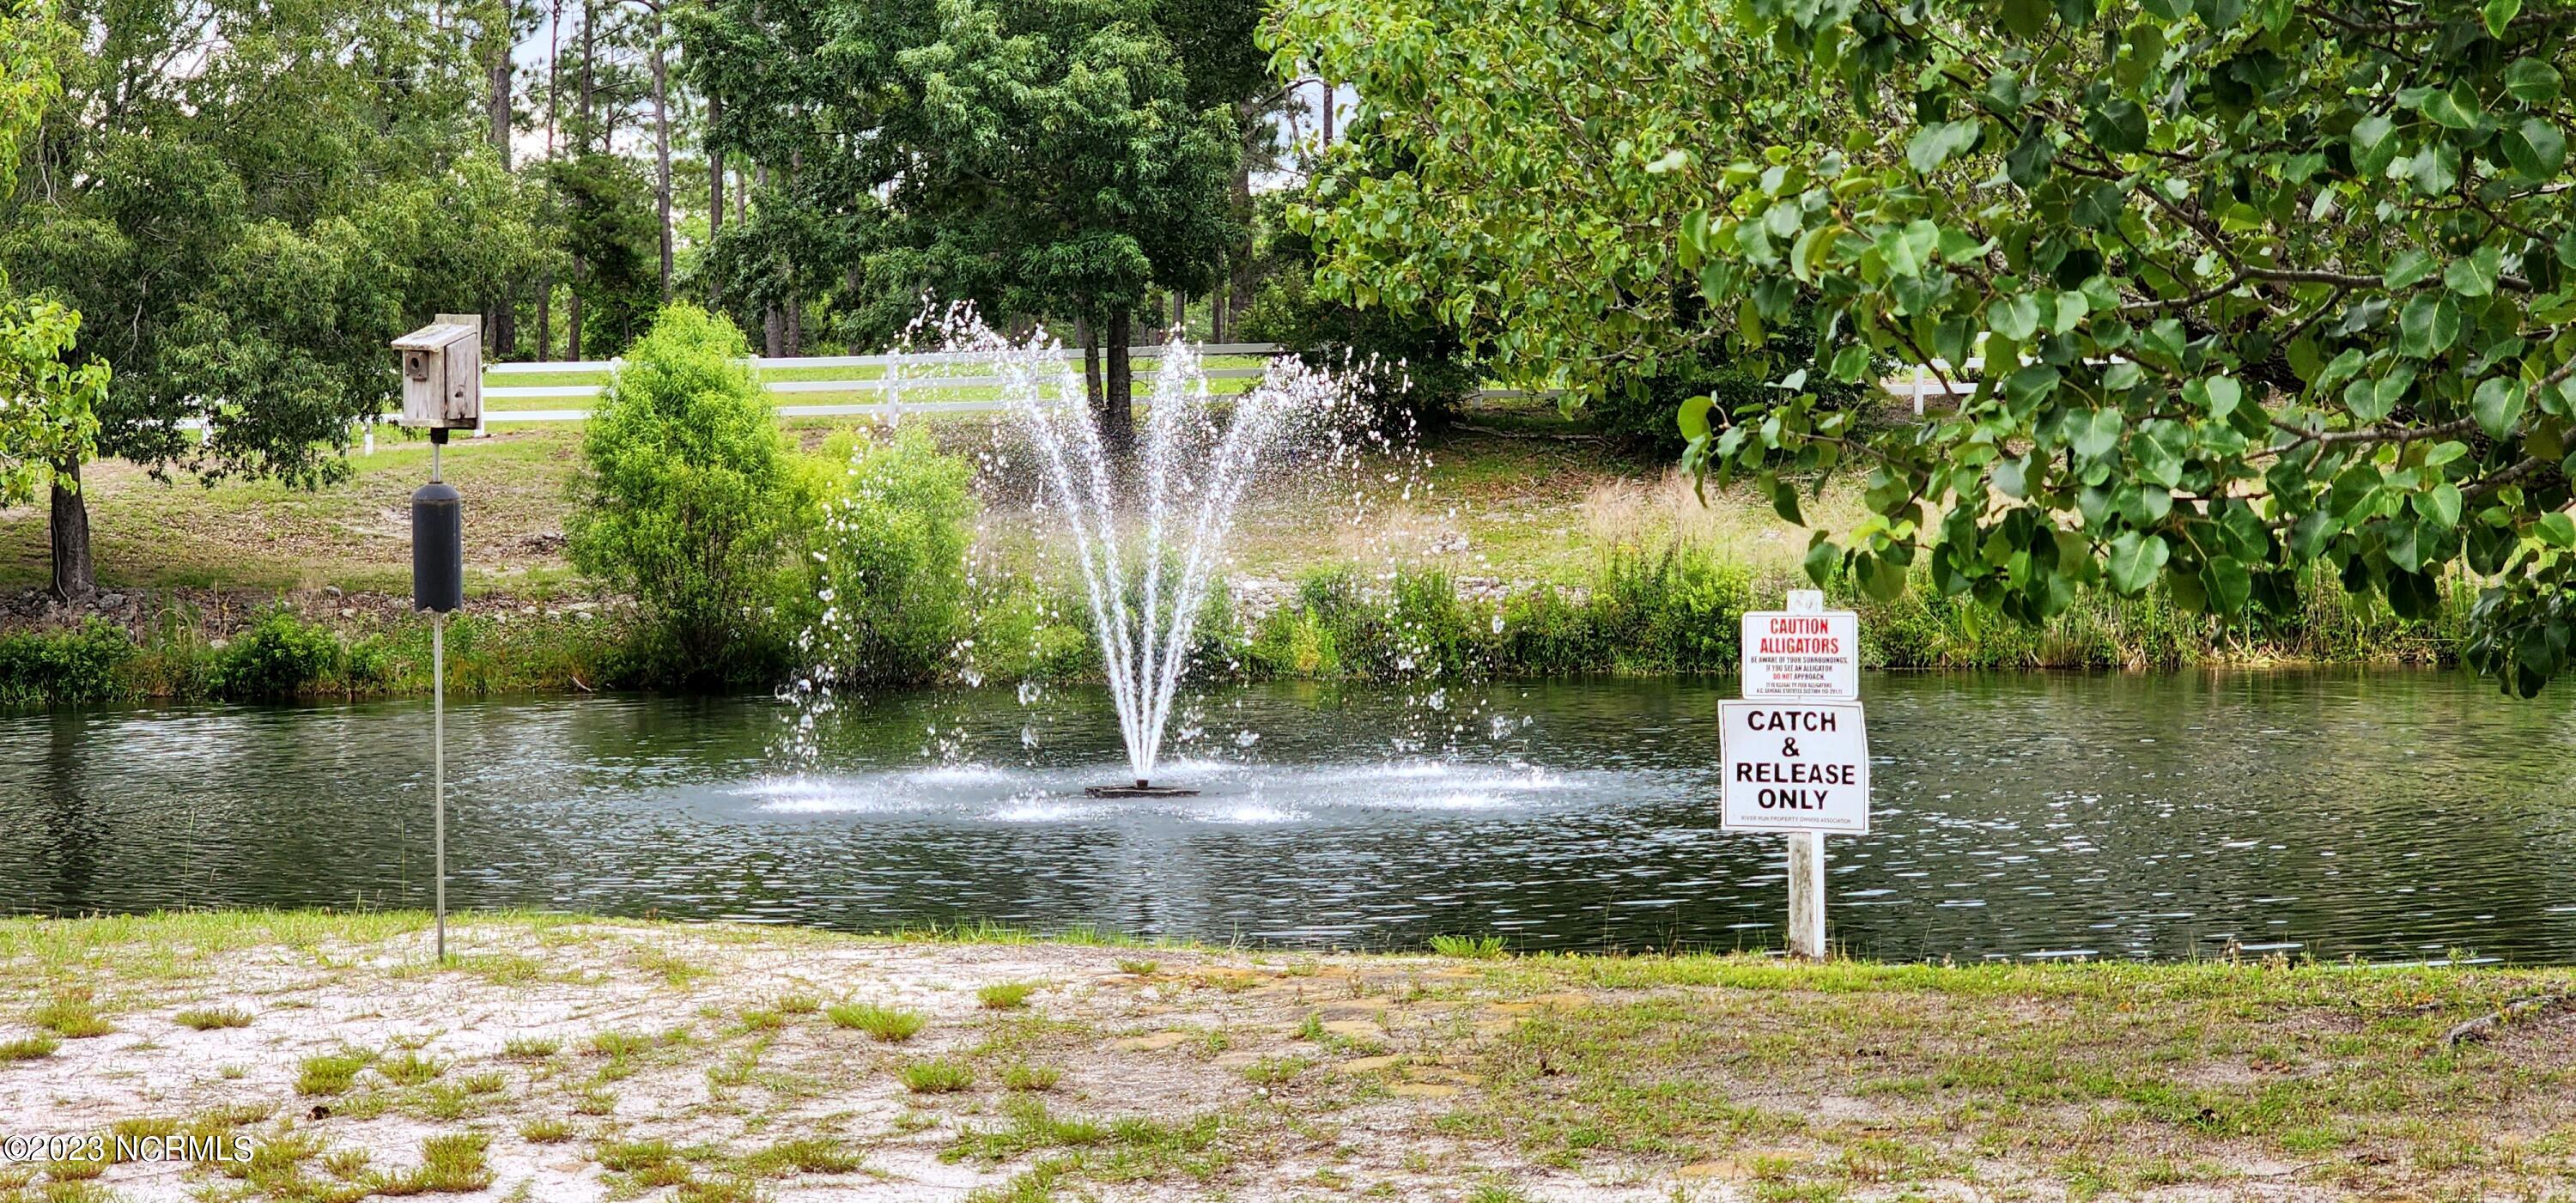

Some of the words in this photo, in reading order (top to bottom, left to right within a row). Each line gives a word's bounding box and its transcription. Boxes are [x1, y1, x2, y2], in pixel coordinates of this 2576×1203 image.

[1771, 618, 1828, 634] CAUTION
[1760, 638, 1839, 653] ALLIGATORS
[1747, 711, 1836, 732] CATCH
[1782, 737, 1800, 756] &
[1736, 763, 1855, 785] RELEASE
[1758, 788, 1828, 810] ONLY
